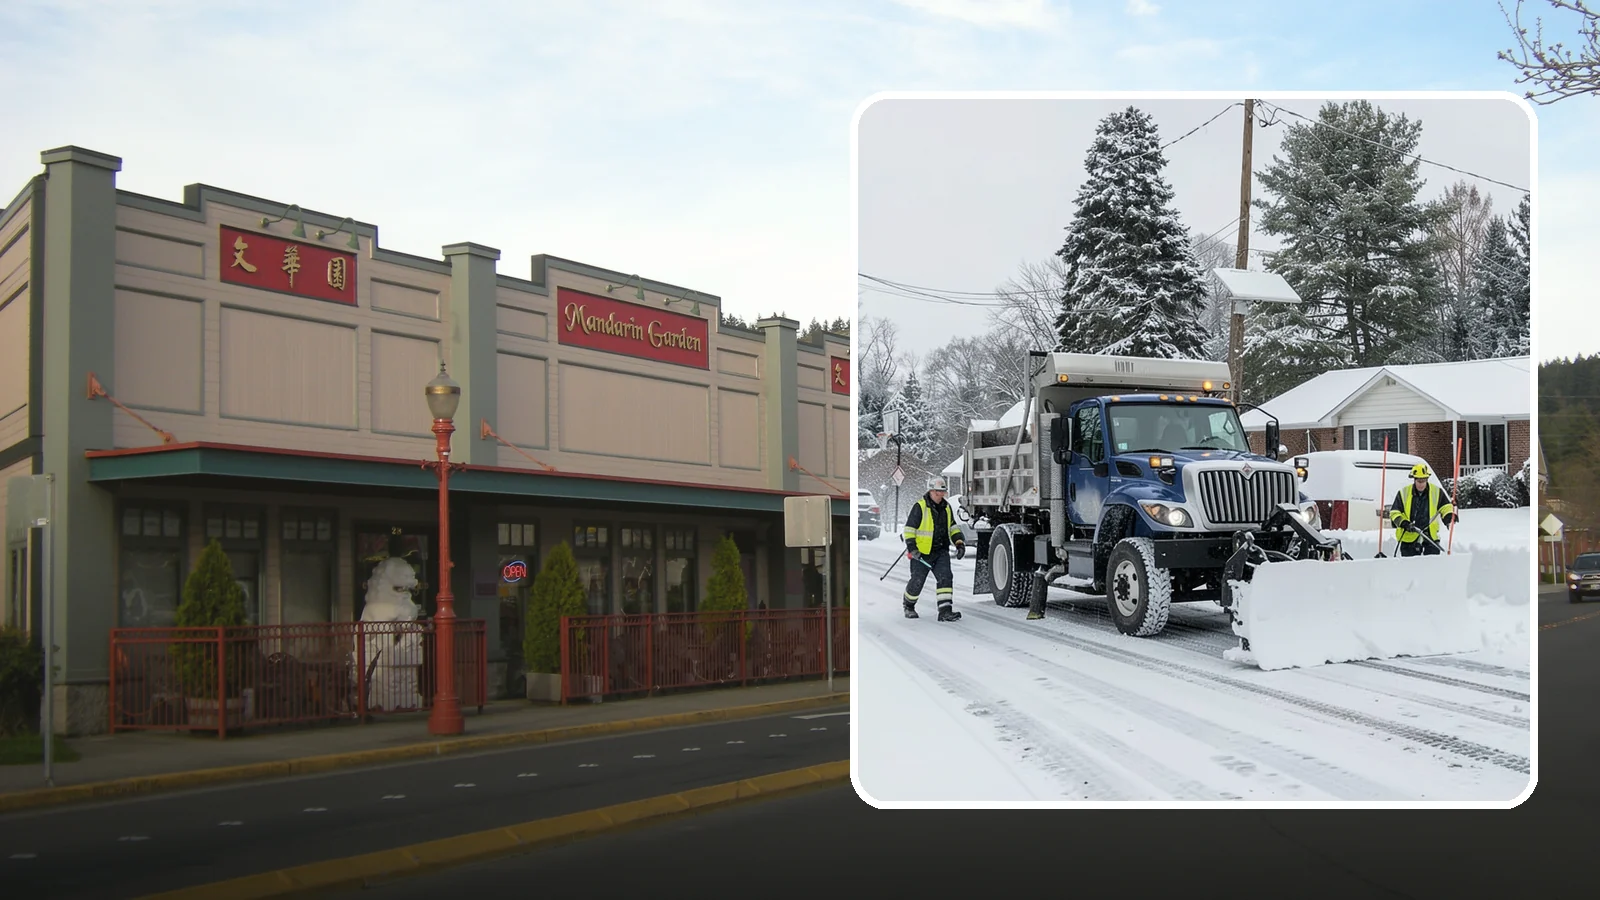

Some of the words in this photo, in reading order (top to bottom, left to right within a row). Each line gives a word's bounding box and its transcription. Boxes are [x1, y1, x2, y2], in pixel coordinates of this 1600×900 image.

[231, 235, 346, 291] 文華園
[564, 302, 643, 341] Mandarin
[648, 320, 702, 352] Garden
[503, 565, 527, 578] OPEN
